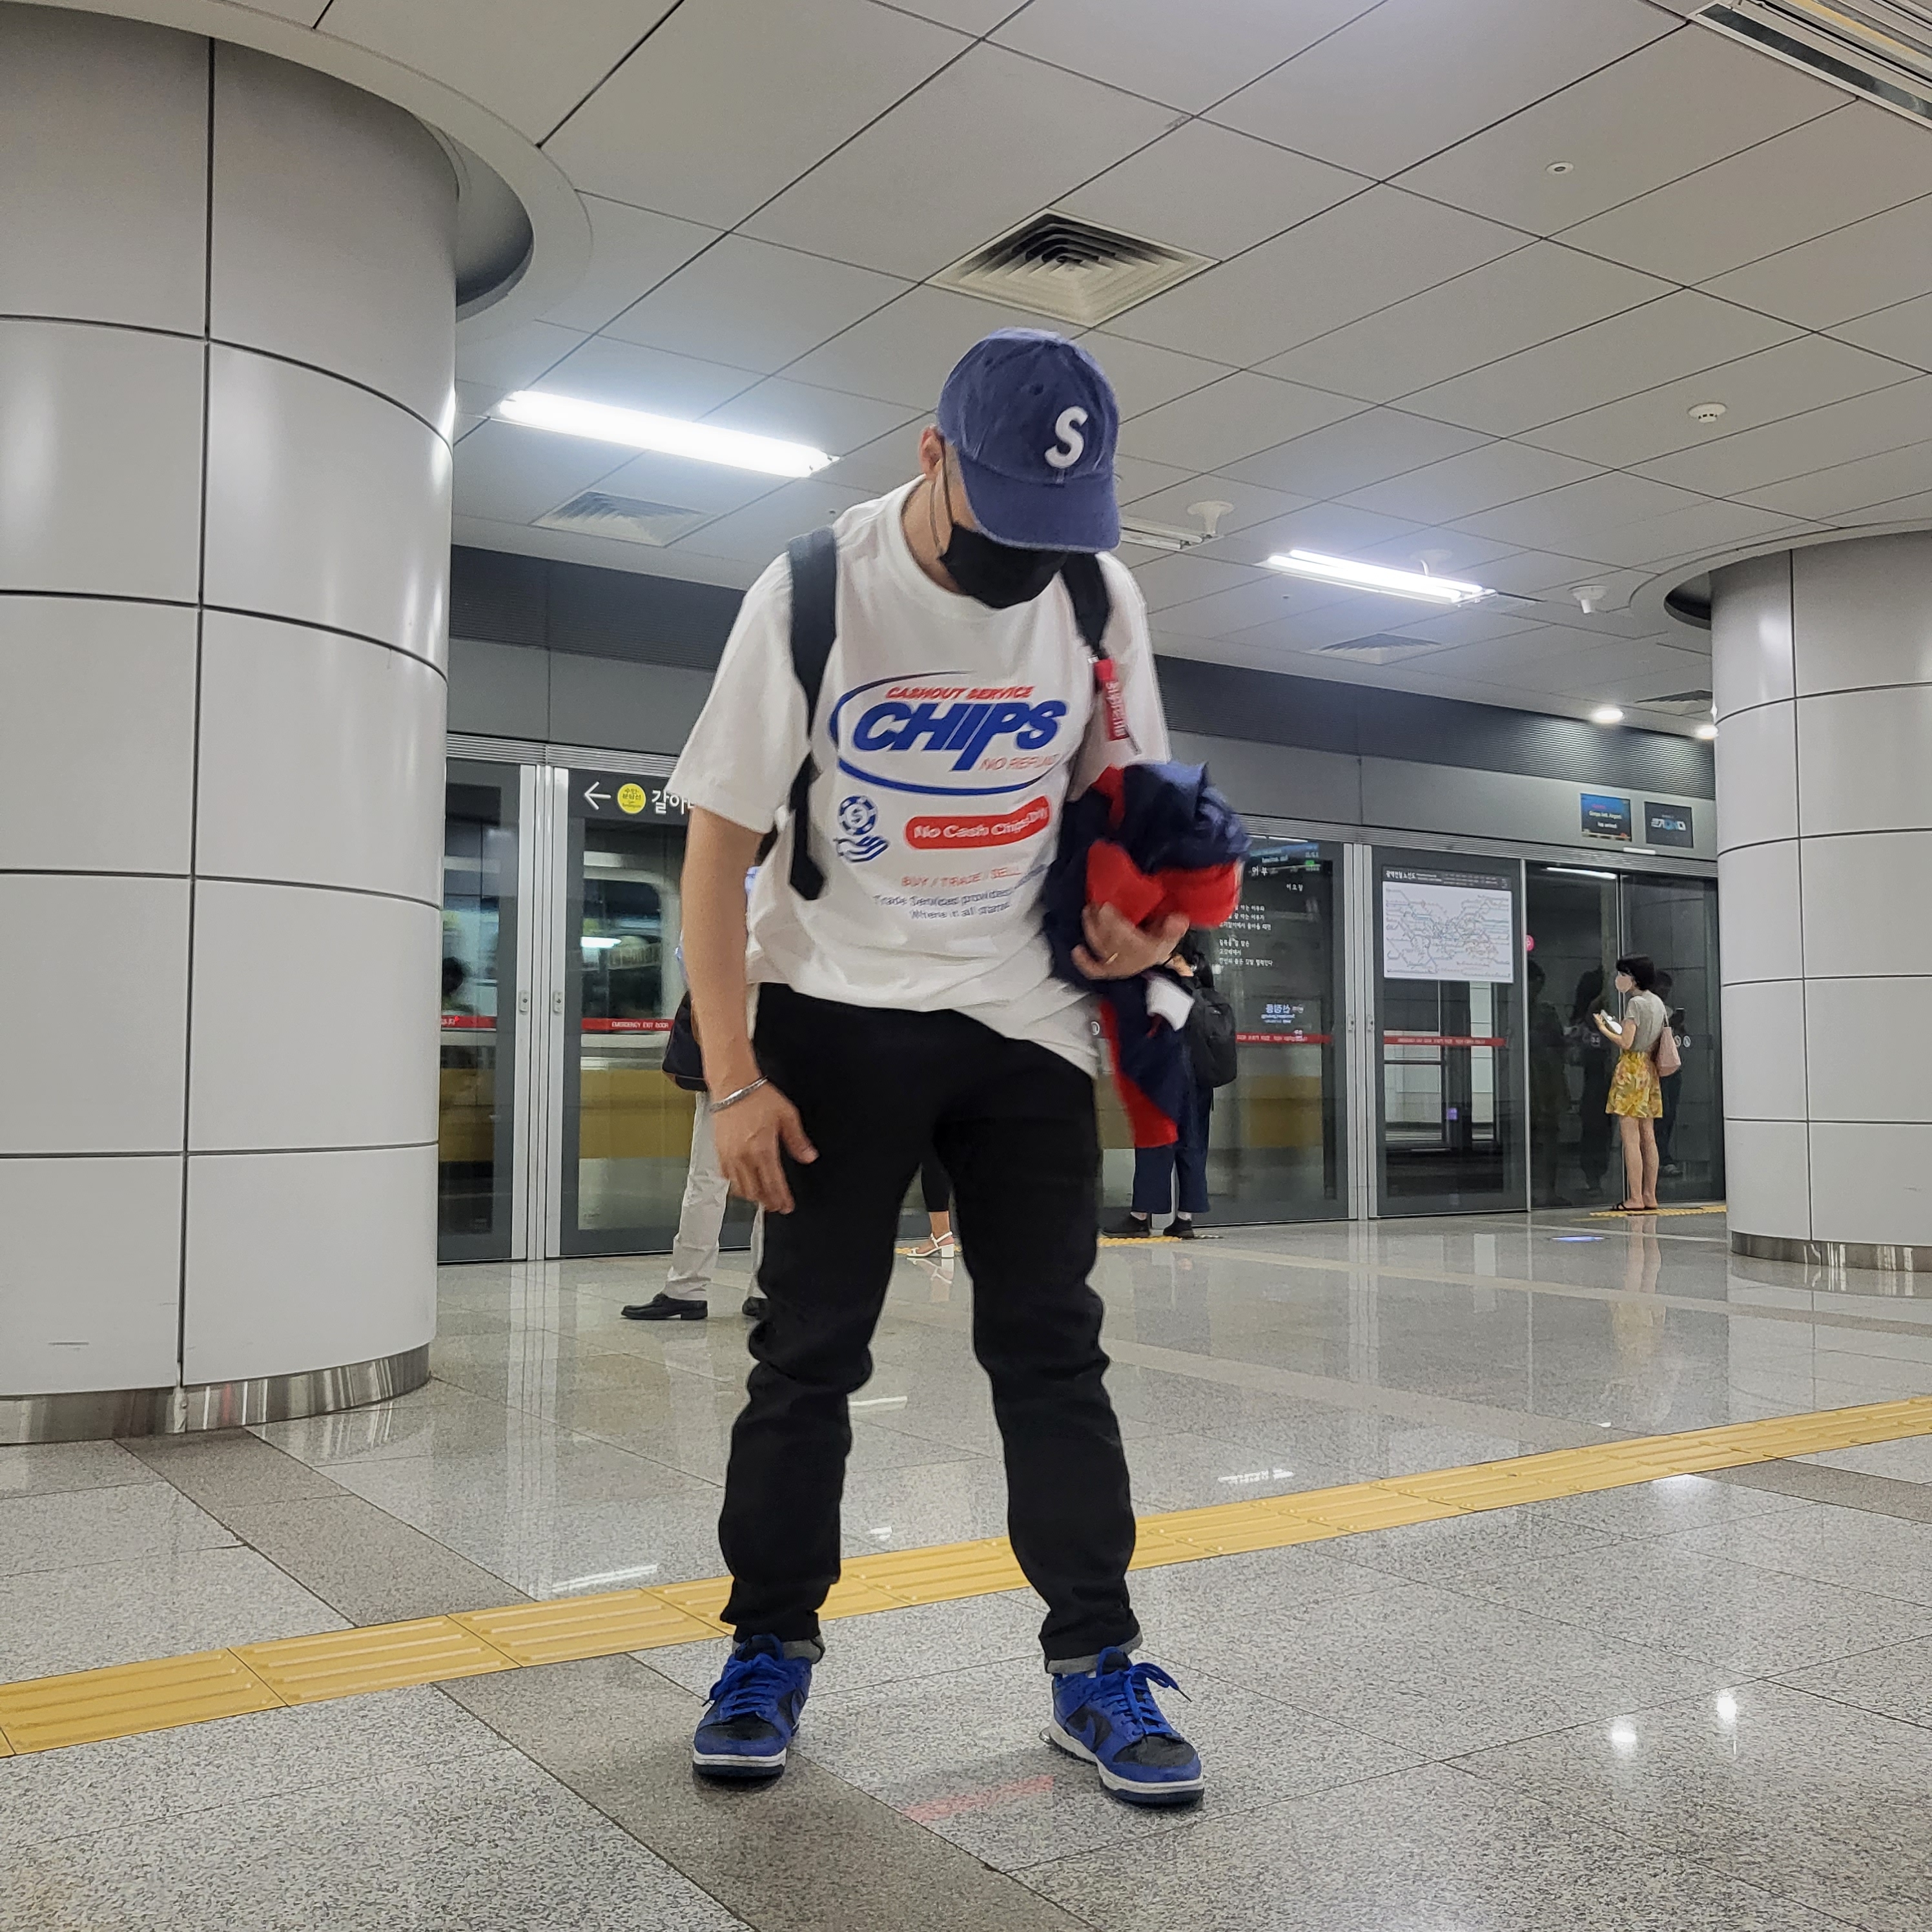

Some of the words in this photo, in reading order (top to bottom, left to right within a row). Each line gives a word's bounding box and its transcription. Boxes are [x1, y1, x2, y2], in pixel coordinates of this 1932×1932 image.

[1044, 406, 1089, 469] S
[885, 686, 969, 699] CASHOUT
[967, 685, 1036, 699] SERVICE
[852, 701, 1067, 771] CHIPS
[979, 757, 1007, 771] NO
[914, 825, 941, 838] No
[943, 823, 989, 838] Cash
[901, 876, 928, 888] BUY
[909, 895, 958, 907] Services
